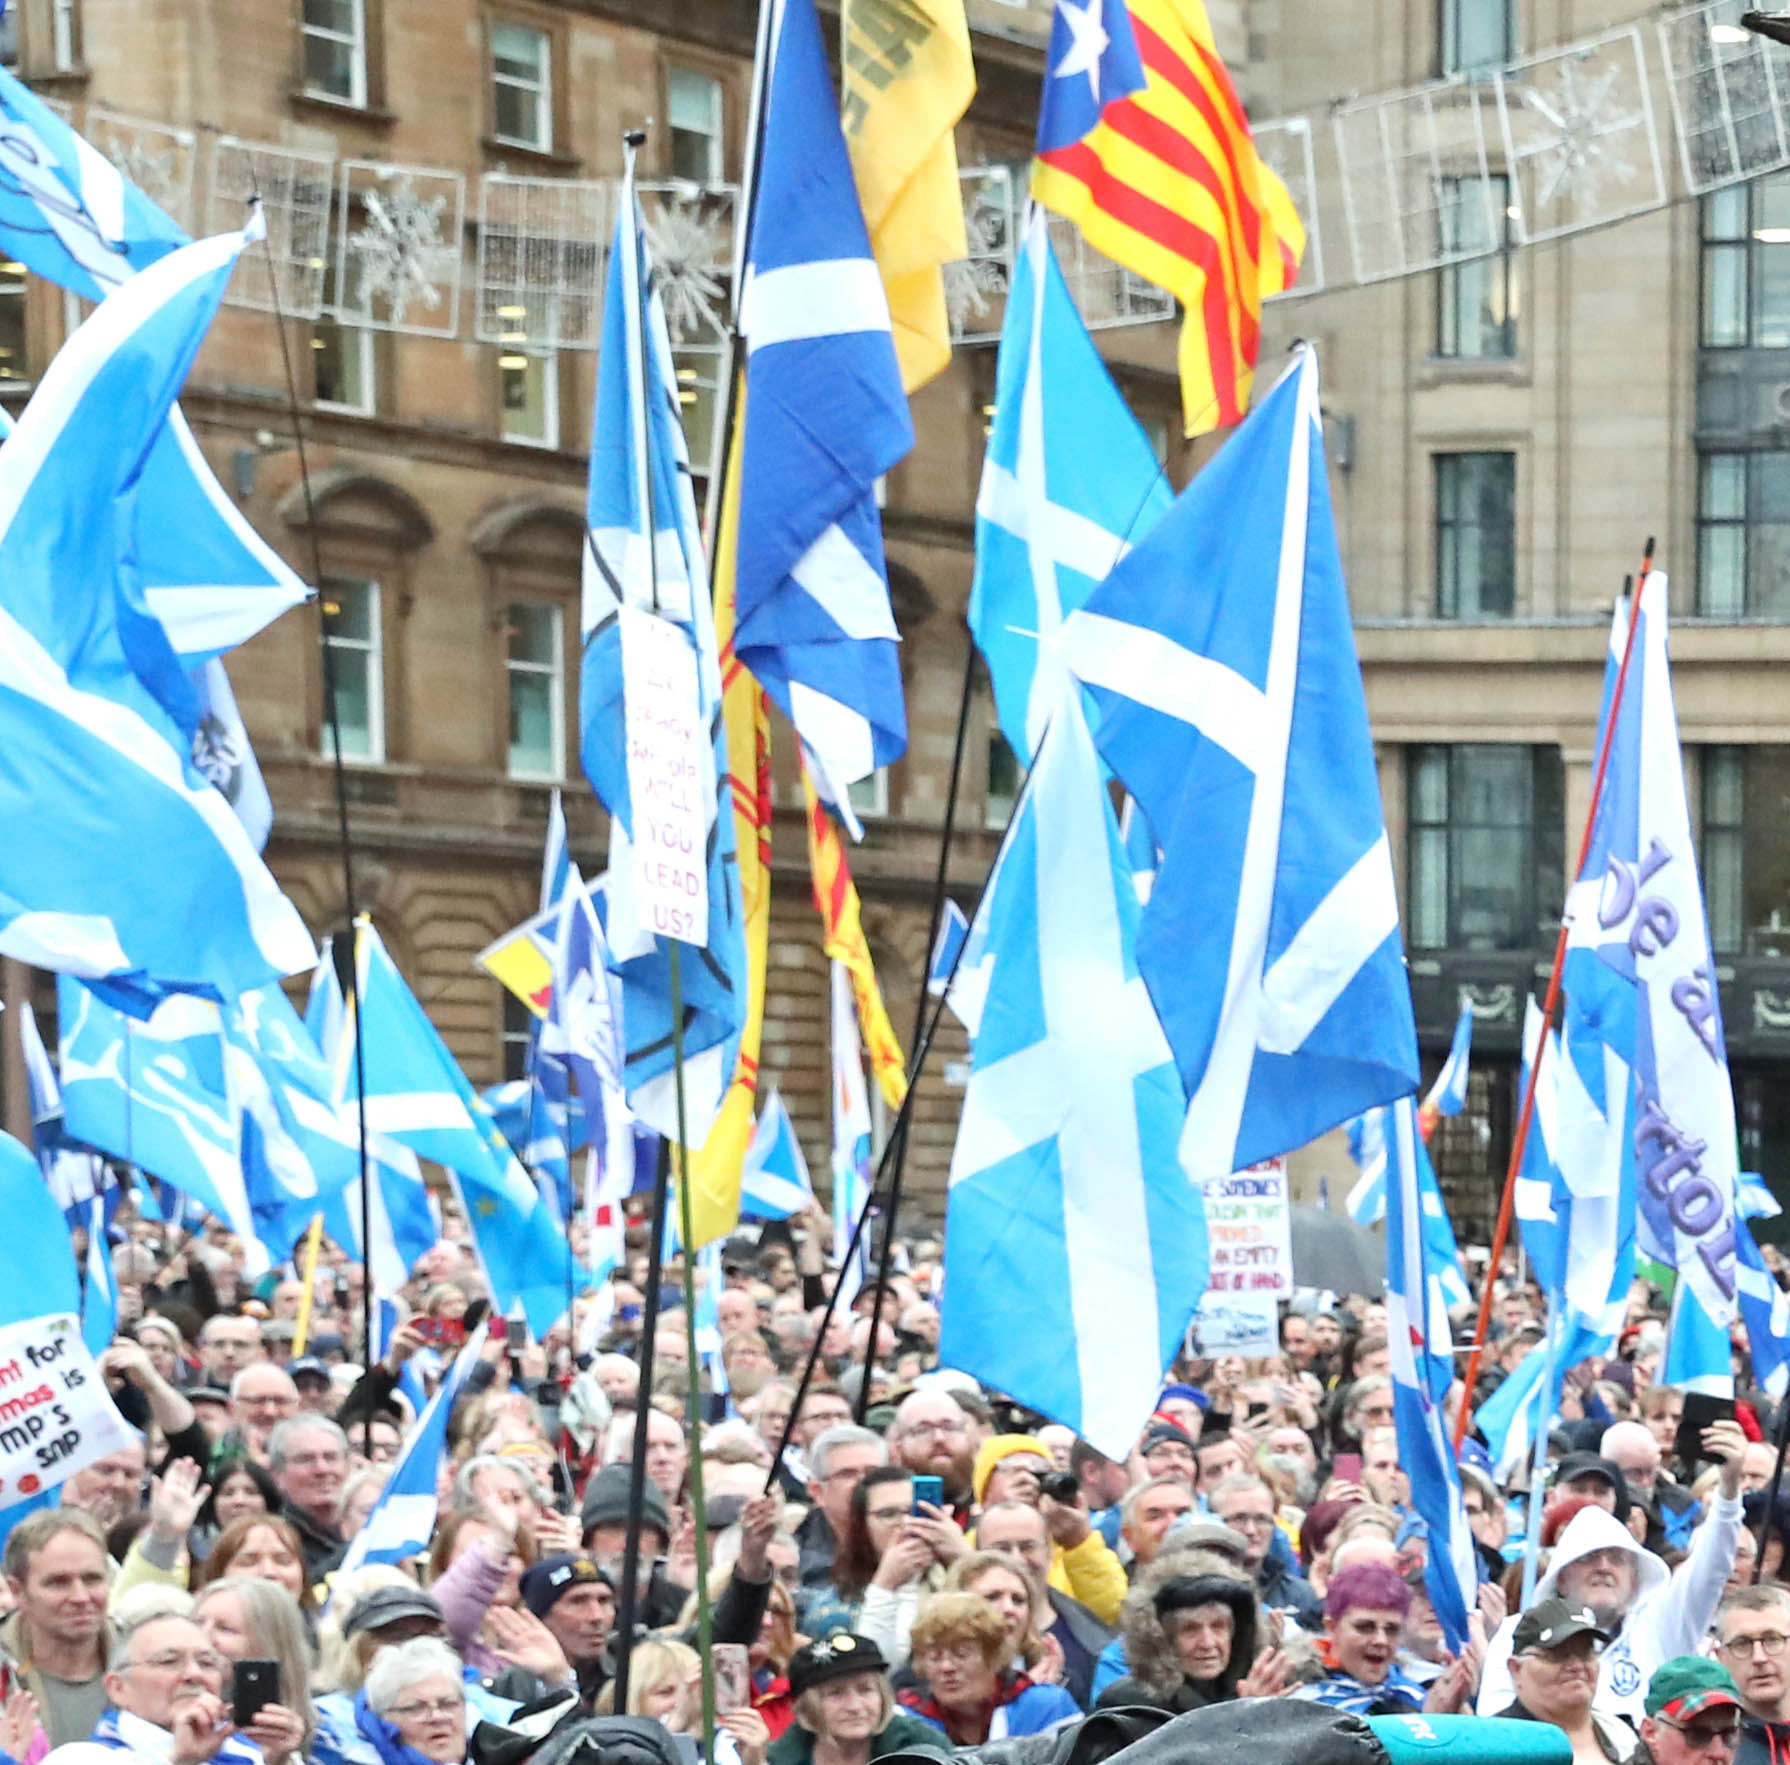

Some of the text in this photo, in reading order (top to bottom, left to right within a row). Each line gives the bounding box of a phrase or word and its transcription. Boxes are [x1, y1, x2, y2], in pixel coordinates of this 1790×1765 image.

[647, 818, 693, 855] YOU
[643, 862, 700, 898] LEAD
[652, 904, 694, 936] US?
[26, 1338, 66, 1368] for
[0, 1368, 86, 1423] mas is
